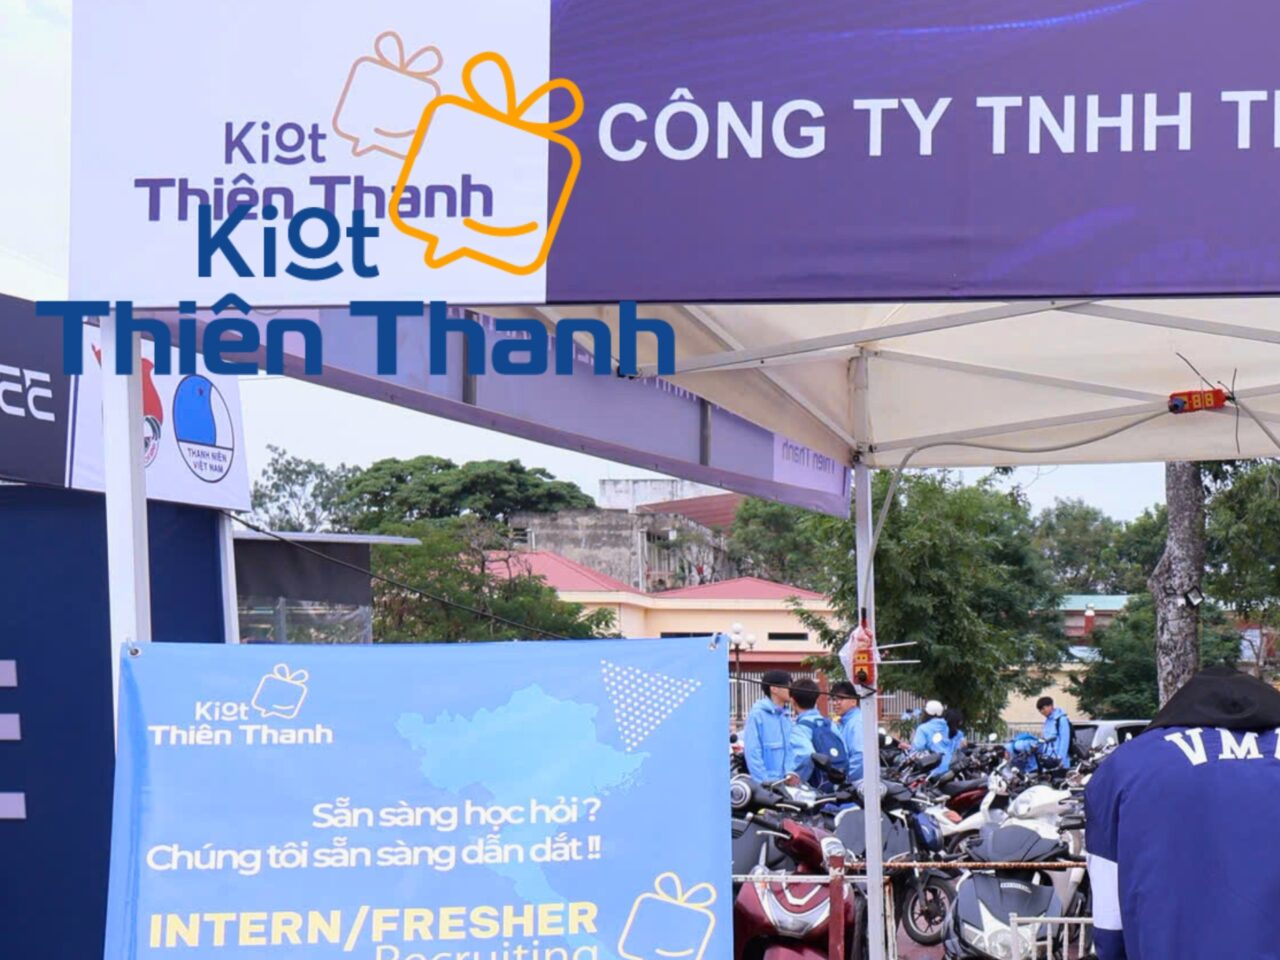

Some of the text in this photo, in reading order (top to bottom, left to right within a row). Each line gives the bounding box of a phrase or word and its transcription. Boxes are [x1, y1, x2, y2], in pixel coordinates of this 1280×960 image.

[223, 121, 328, 166] Kiot
[598, 88, 825, 161] CÔNG
[854, 98, 952, 156] TY
[976, 92, 1192, 155] TNHH
[195, 701, 250, 721] Kiot
[147, 723, 334, 746] Thiên Thanh
[311, 796, 601, 833] Sẵn sàng học hỏi ?
[146, 831, 601, 876] Chúng tôi sẵn sàng dẫn dắt !!
[149, 901, 599, 952] INTERN/FRESHER
